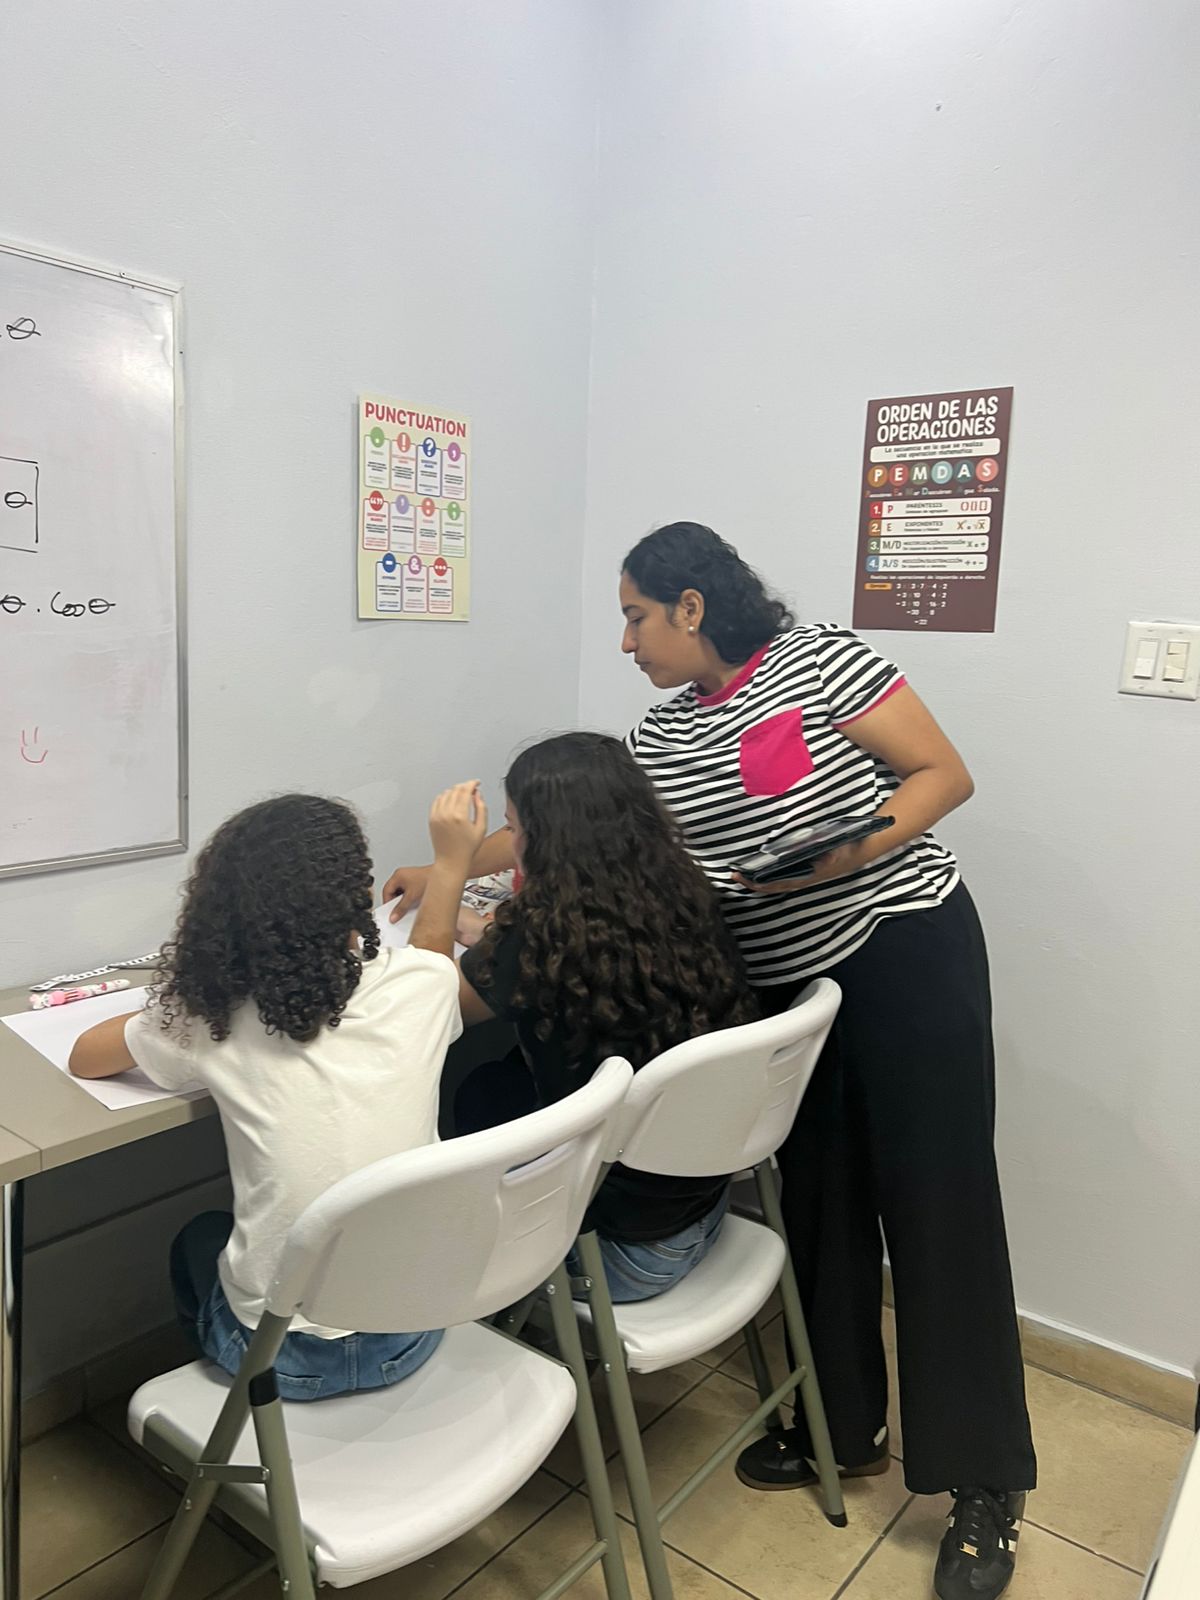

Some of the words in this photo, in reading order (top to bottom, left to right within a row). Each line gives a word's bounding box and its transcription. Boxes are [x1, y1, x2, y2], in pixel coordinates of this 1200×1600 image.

[878, 402, 932, 424] ORDEN
[938, 400, 960, 419] DE
[966, 396, 998, 417] LAS
[365, 402, 466, 438] PUNCTUATION
[876, 416, 996, 443] OPERACIONES
[888, 505, 893, 513] P
[872, 523, 880, 532] 2.
[886, 523, 892, 531] E
[870, 541, 879, 550] 3.
